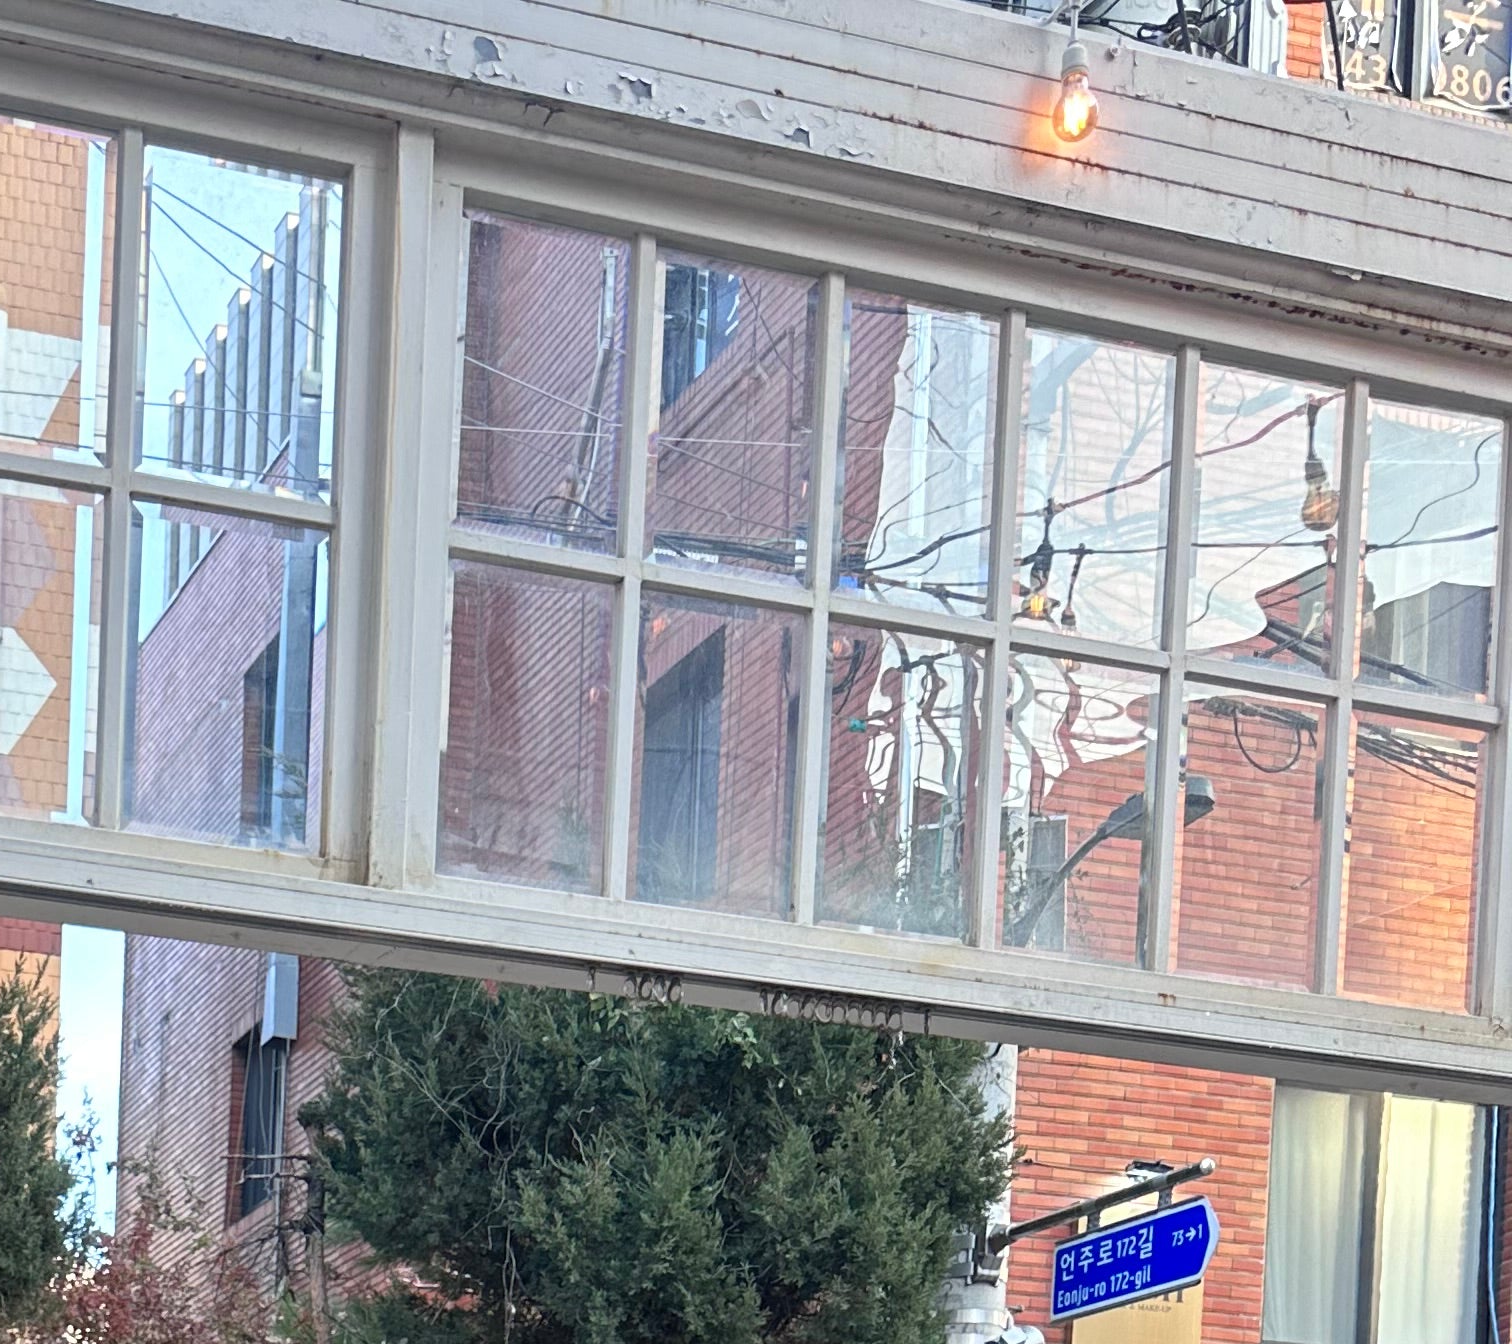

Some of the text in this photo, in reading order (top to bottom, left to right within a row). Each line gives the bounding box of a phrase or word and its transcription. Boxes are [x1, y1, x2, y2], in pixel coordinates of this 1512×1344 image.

[1060, 1226, 1153, 1281] 언주로172길
[1172, 1224, 1203, 1247] 73 1
[1057, 1265, 1151, 1308] Eonju-ro 172-gil
